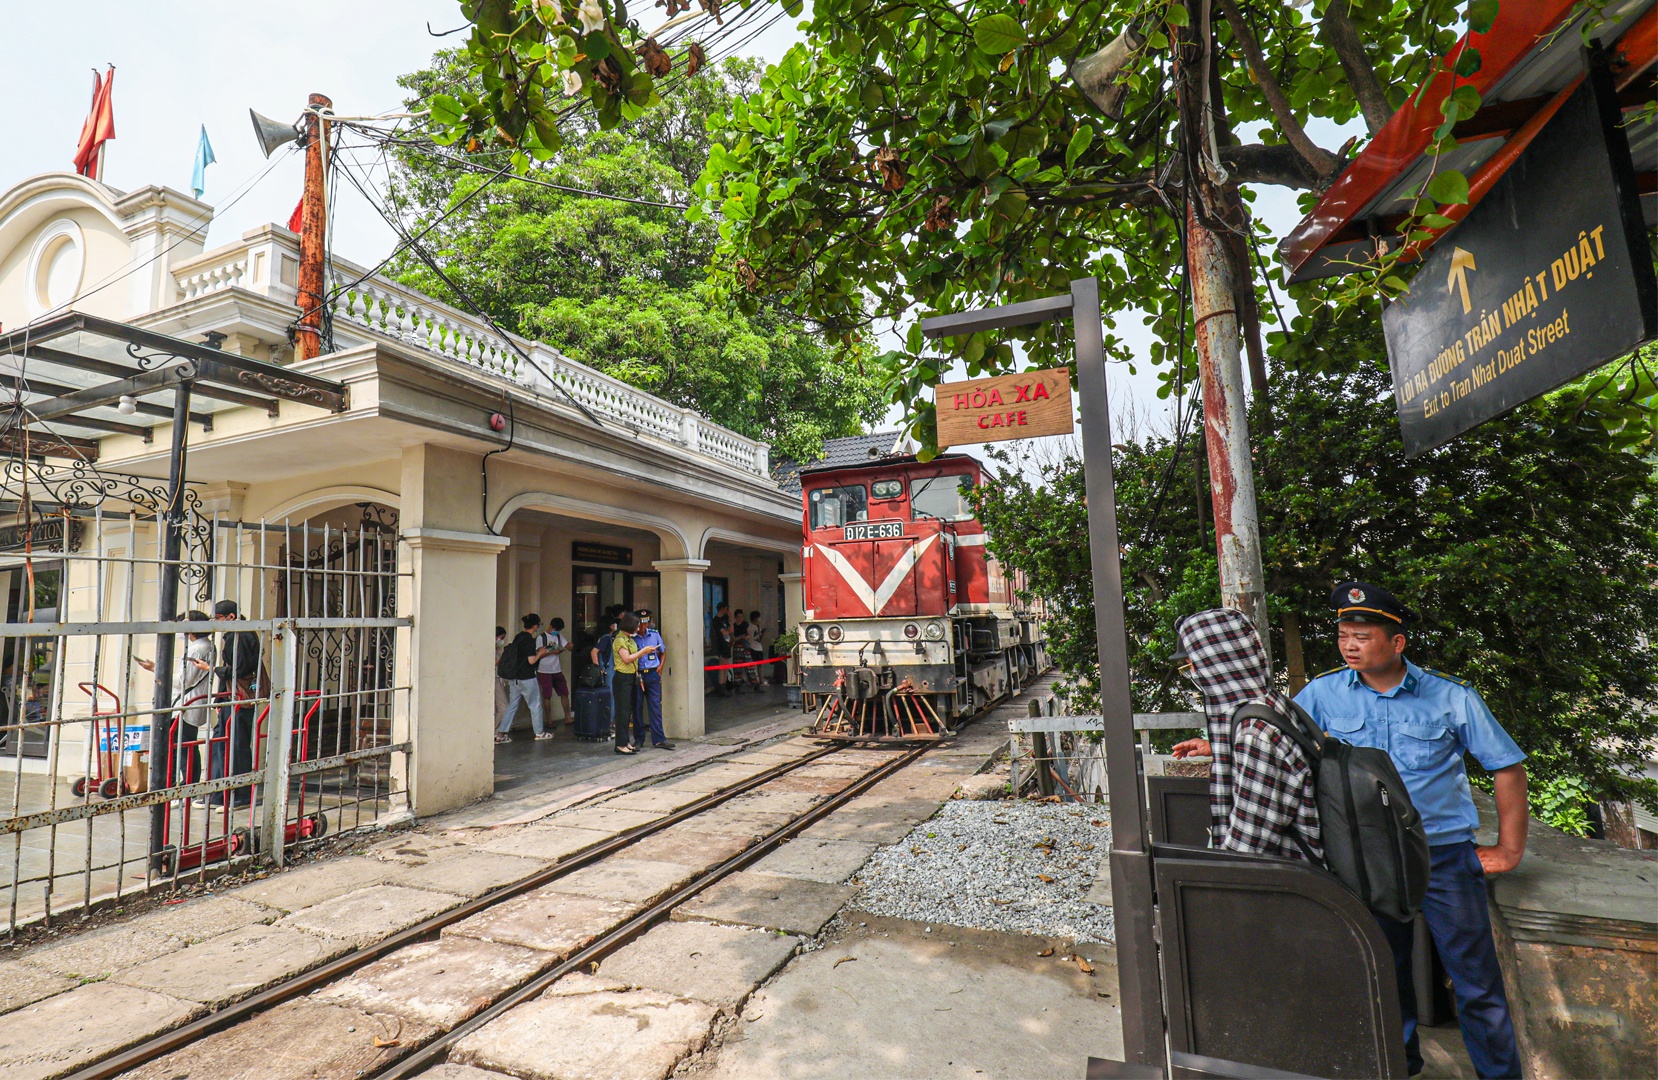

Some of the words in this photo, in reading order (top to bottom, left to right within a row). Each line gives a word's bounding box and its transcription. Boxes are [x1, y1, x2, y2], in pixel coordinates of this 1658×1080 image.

[1400, 373, 1415, 405] LỐI
[1414, 369, 1429, 395] RA
[1428, 340, 1466, 384] ĐƯỜNG
[1464, 308, 1502, 356] TRẦN
[1502, 270, 1548, 329] NHẬT
[1551, 224, 1605, 292] DUẬT
[1423, 394, 1439, 419] Exit
[1441, 390, 1450, 409] to
[1449, 378, 1472, 402] Tran
[1471, 357, 1497, 390] Nhat
[1497, 337, 1526, 375] Duat
[1527, 307, 1570, 355] Street
[953, 387, 1004, 410] HỎA
[1015, 382, 1049, 403] XA
[977, 411, 1028, 429] CAFE
[17, 521, 65, 544] SATION
